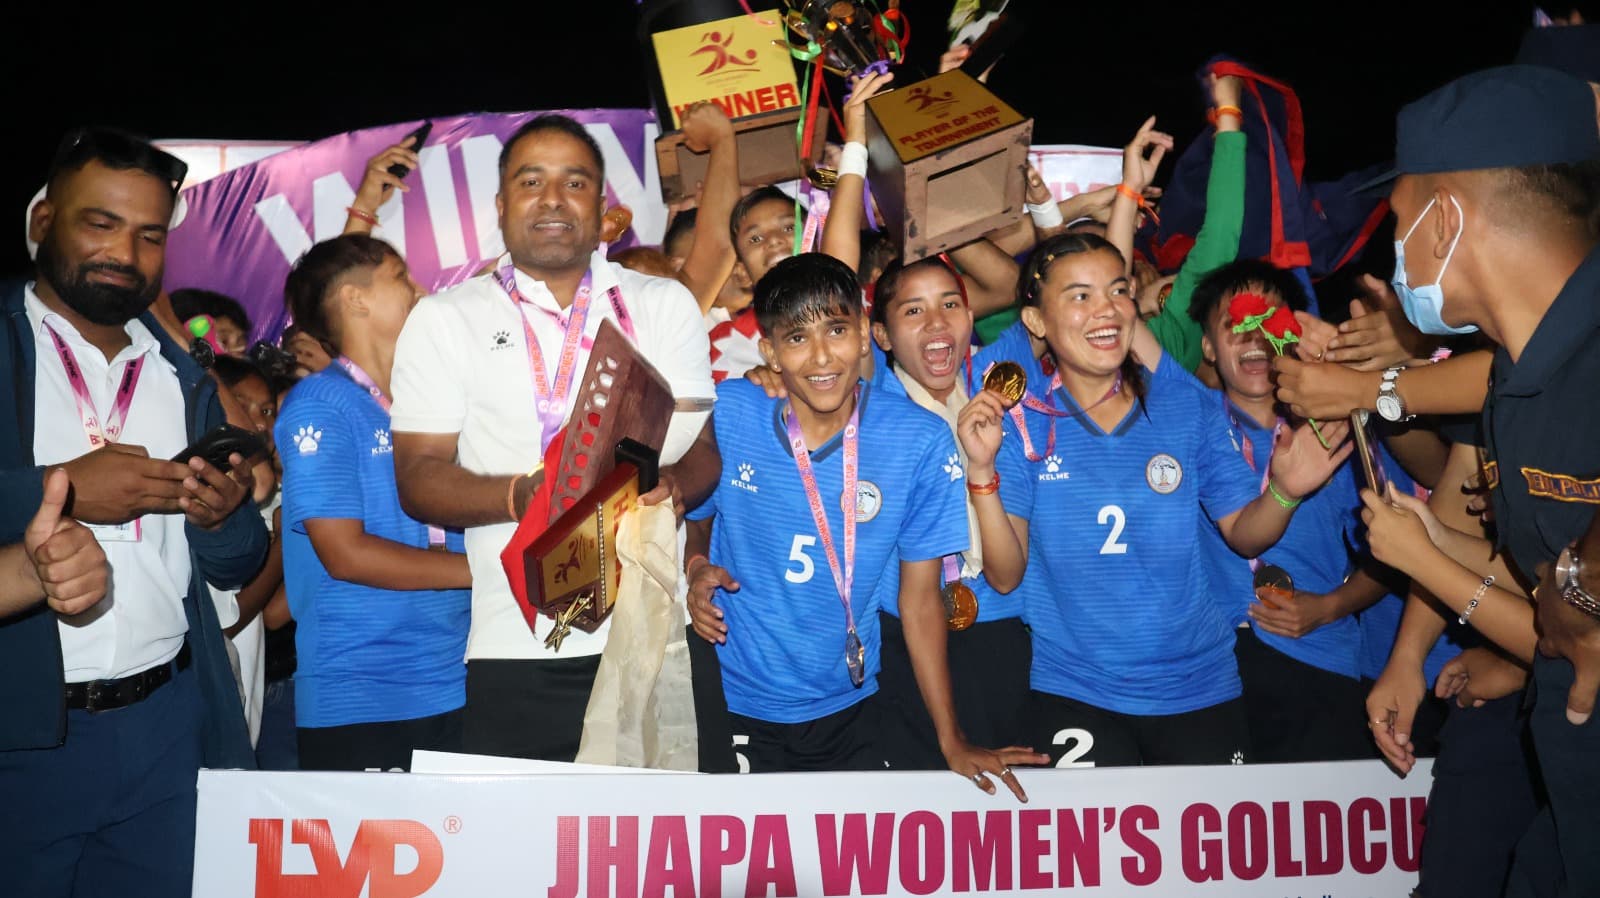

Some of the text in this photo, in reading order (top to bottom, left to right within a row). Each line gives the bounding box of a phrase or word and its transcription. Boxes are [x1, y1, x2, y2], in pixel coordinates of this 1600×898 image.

[898, 122, 952, 145] PLAYER
[951, 114, 969, 127] OF
[972, 104, 1001, 119] THE
[731, 479, 759, 493] KELME
[1039, 472, 1070, 481] KELME
[1097, 505, 1128, 555] 2
[785, 534, 817, 584] 5
[1053, 728, 1096, 768] 2
[548, 815, 797, 898] JHAPA
[816, 804, 1162, 897] WOMEN'S
